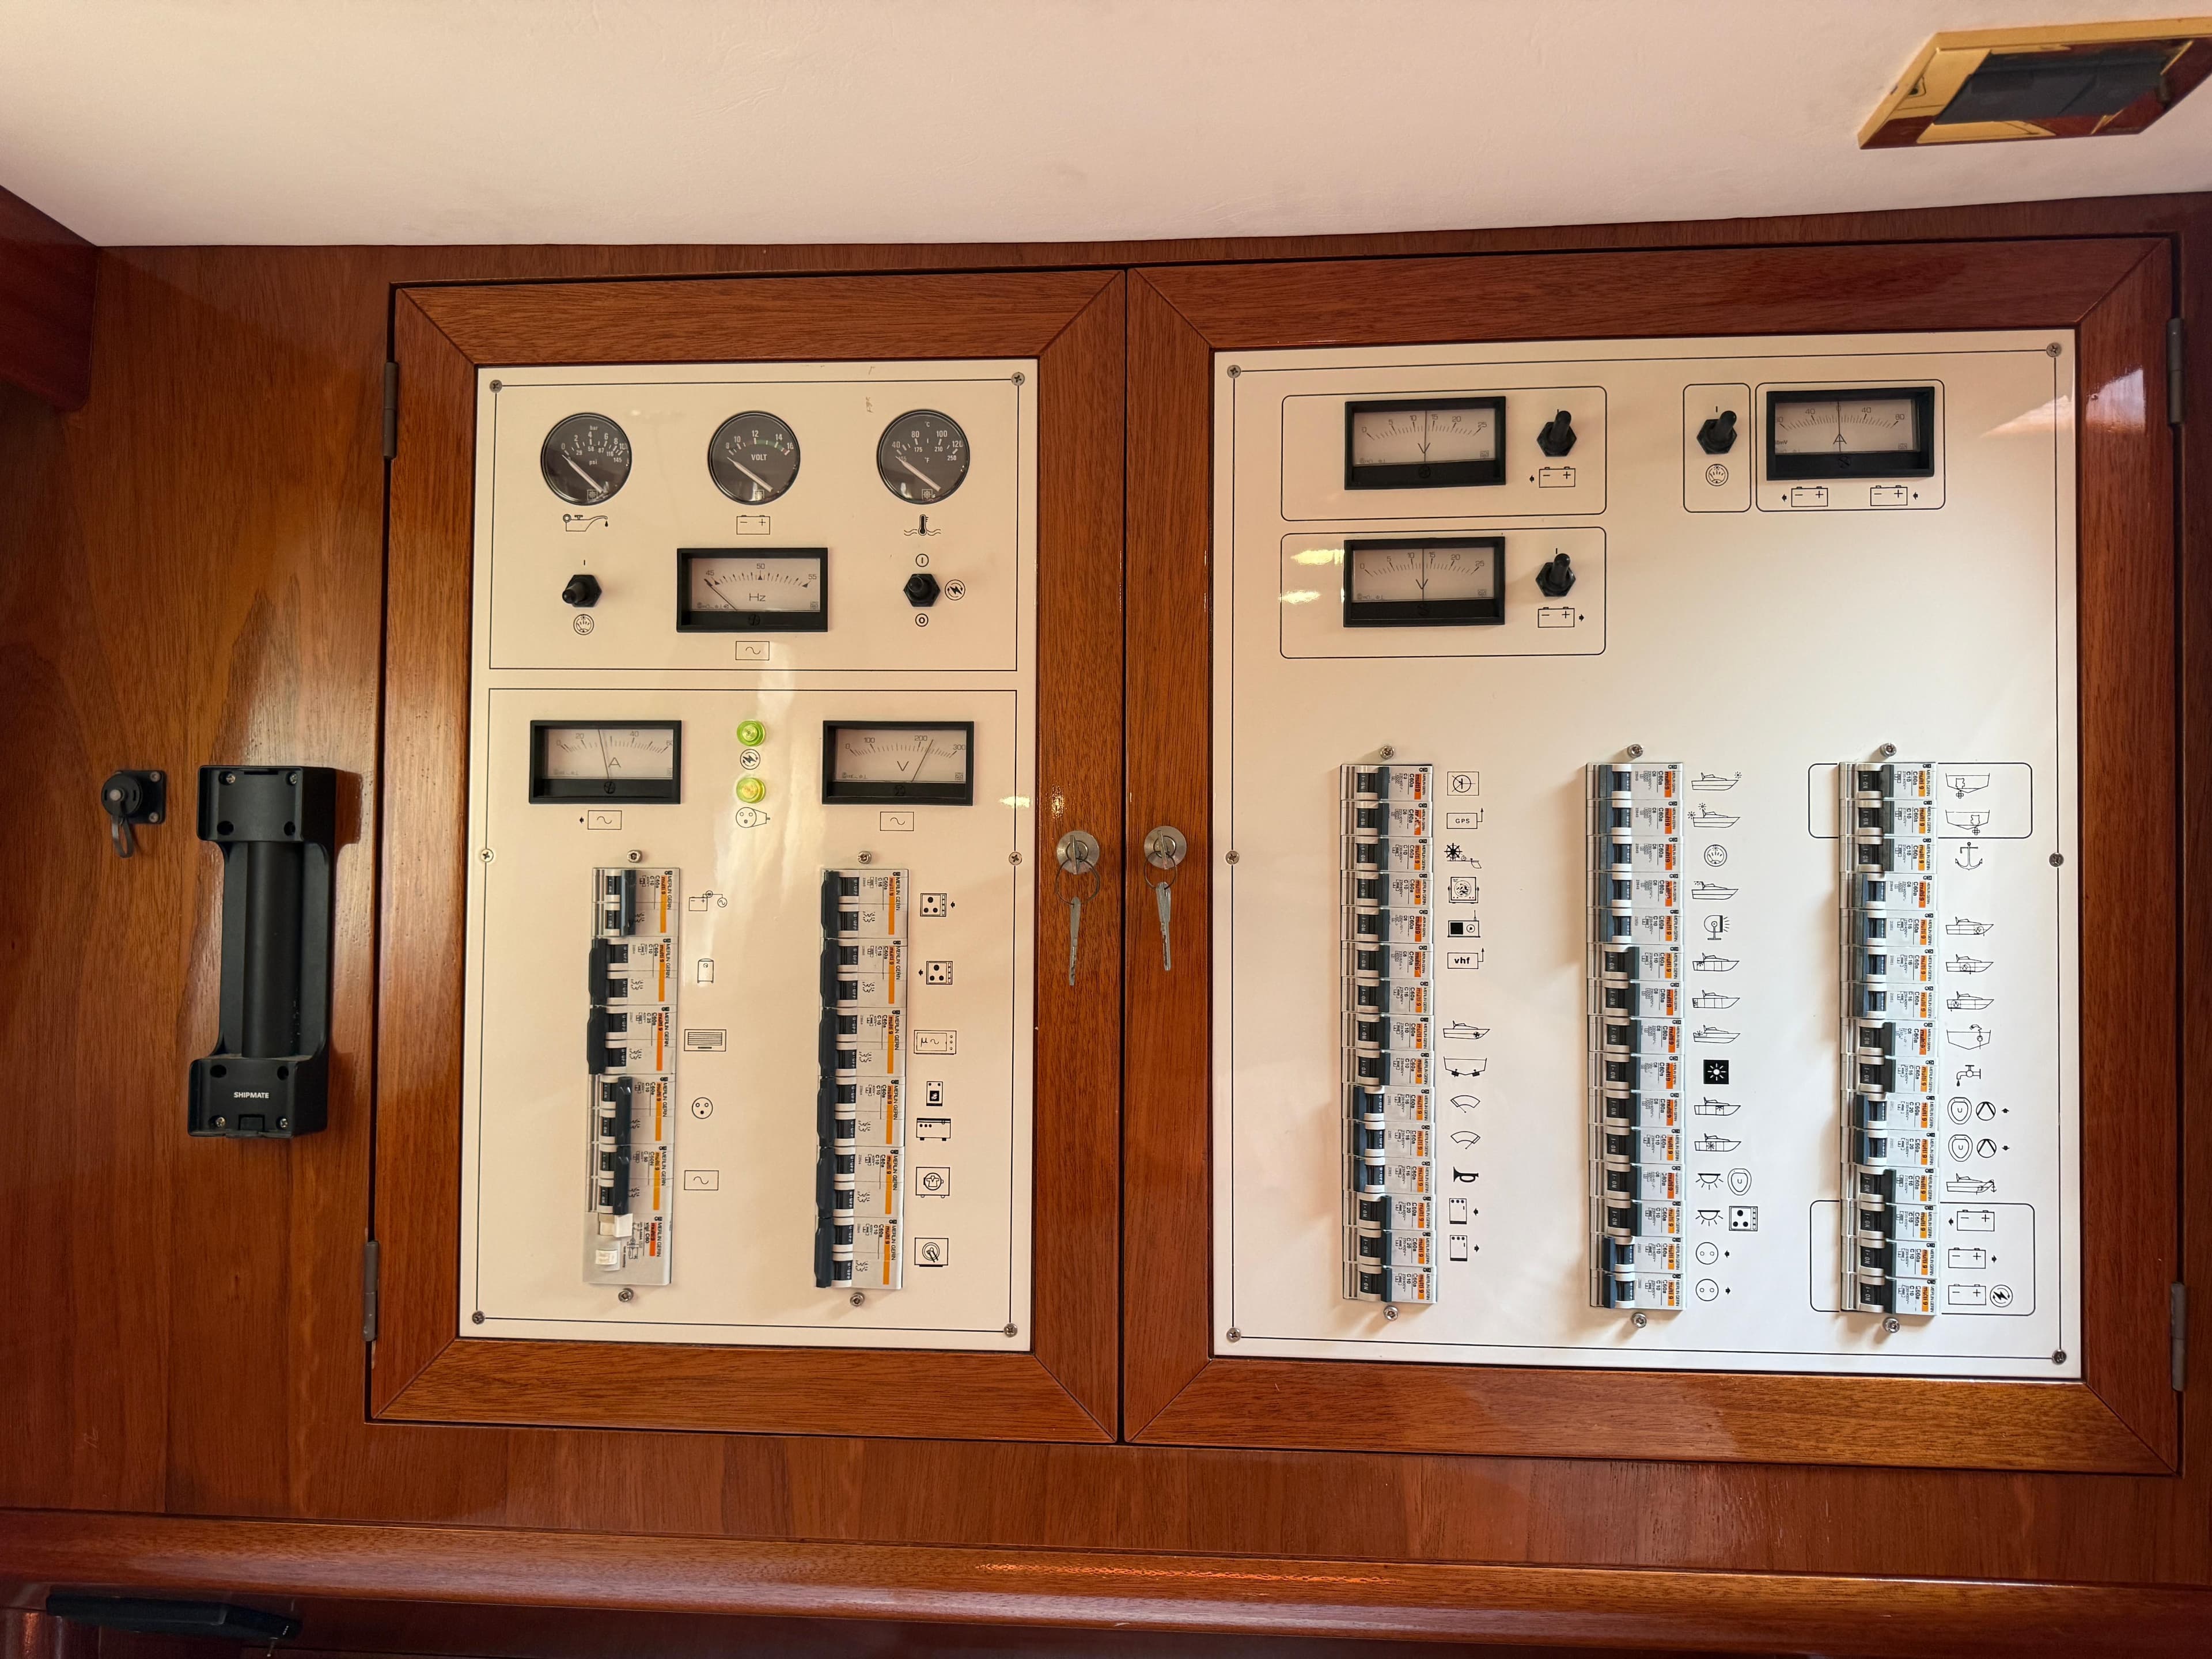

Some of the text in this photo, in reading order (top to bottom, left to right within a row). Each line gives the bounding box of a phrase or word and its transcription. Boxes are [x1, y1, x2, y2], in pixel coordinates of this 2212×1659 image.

[749, 593, 766, 601] Hz
[608, 757, 621, 767] A
[897, 761, 909, 771] V
[1454, 956, 1470, 964] vhf
